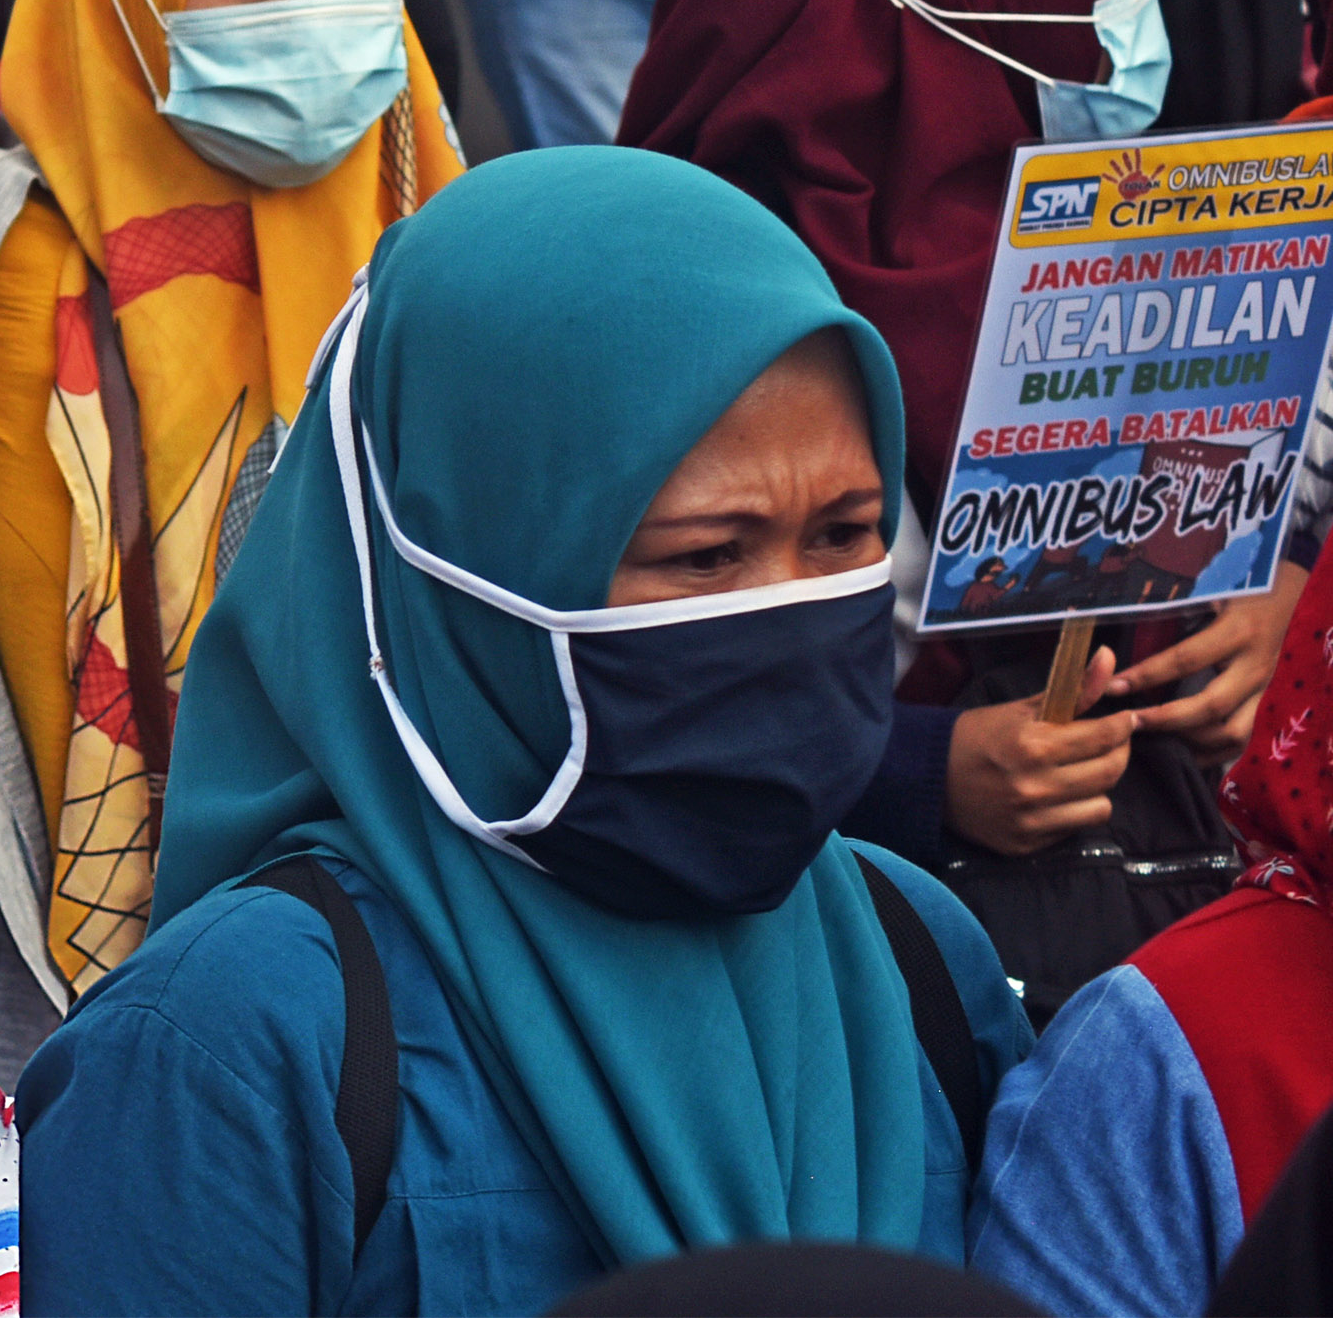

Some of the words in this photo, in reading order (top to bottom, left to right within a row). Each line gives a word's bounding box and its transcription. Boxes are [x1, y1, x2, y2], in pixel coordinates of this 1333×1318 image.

[1168, 152, 1333, 192] OMNIBUSLA
[1020, 182, 1100, 219] SPN
[1110, 195, 1218, 227] CIPTA
[1021, 251, 1164, 293] JANGAN
[1170, 235, 1330, 280] MATIKAN
[1002, 275, 1317, 366] KEADILAN
[1019, 364, 1124, 404] BUAT
[1130, 351, 1270, 394] BURUH
[969, 417, 1111, 459] SEGERA
[1119, 396, 1301, 444] BATALKAN
[1153, 456, 1225, 483] OMNIUS
[937, 470, 1171, 555] OMNIBUS
[1175, 451, 1299, 536] LAW
